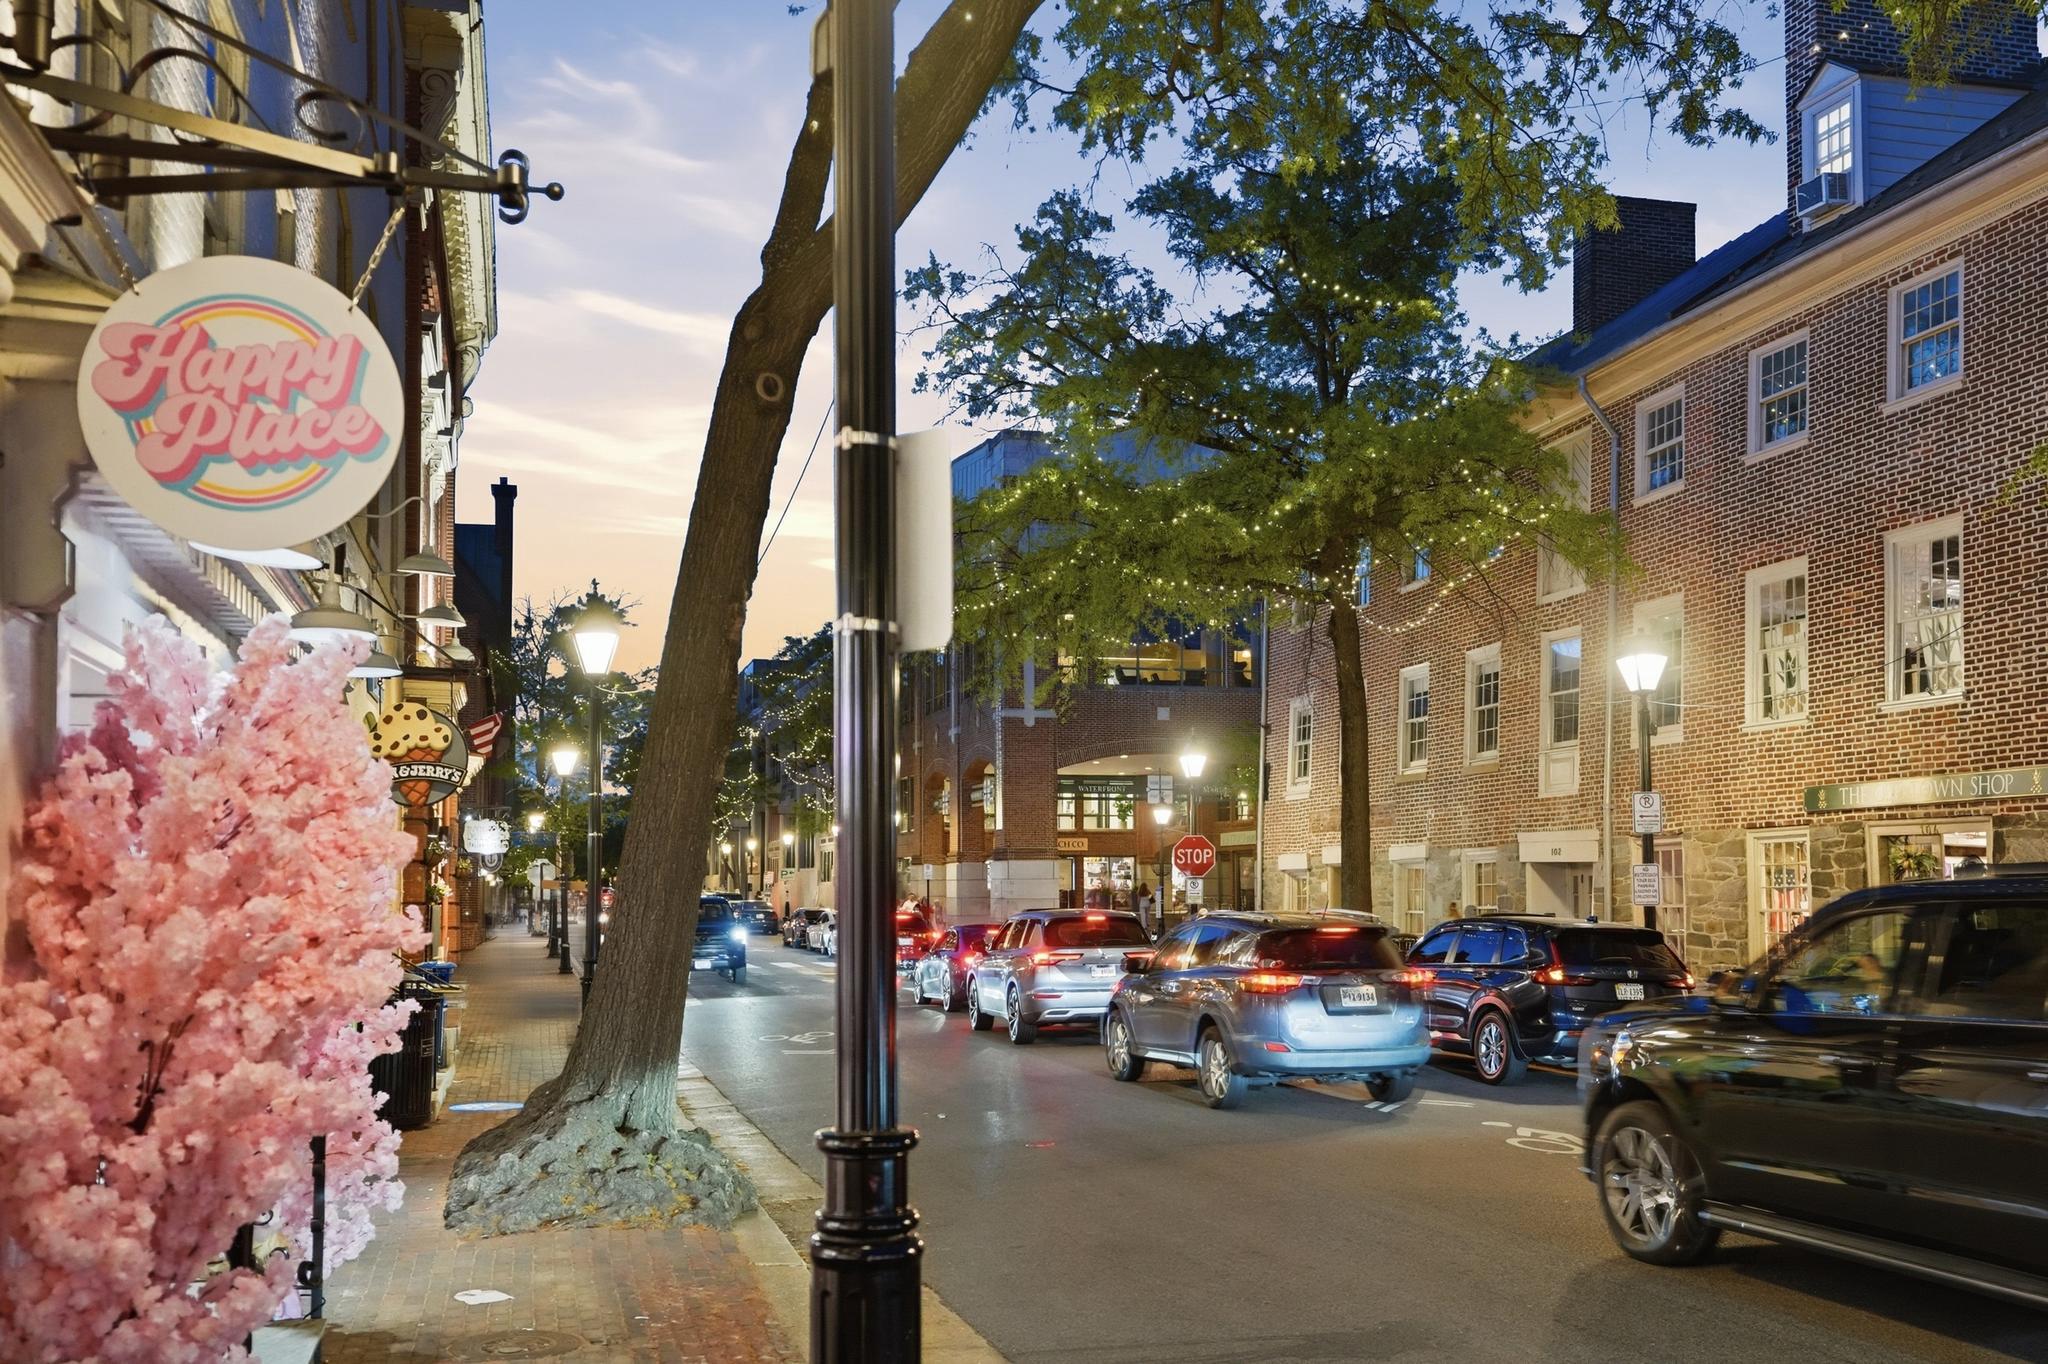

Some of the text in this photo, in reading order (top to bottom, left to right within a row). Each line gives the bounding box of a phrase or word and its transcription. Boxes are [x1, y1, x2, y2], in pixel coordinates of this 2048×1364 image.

[92, 321, 363, 412] Happy
[136, 391, 385, 486] Place
[1078, 785, 1126, 793] WATERFRONT
[1970, 773, 2014, 797] SHOP
[1176, 848, 1213, 864] STOP
[1551, 848, 1562, 856] 102
